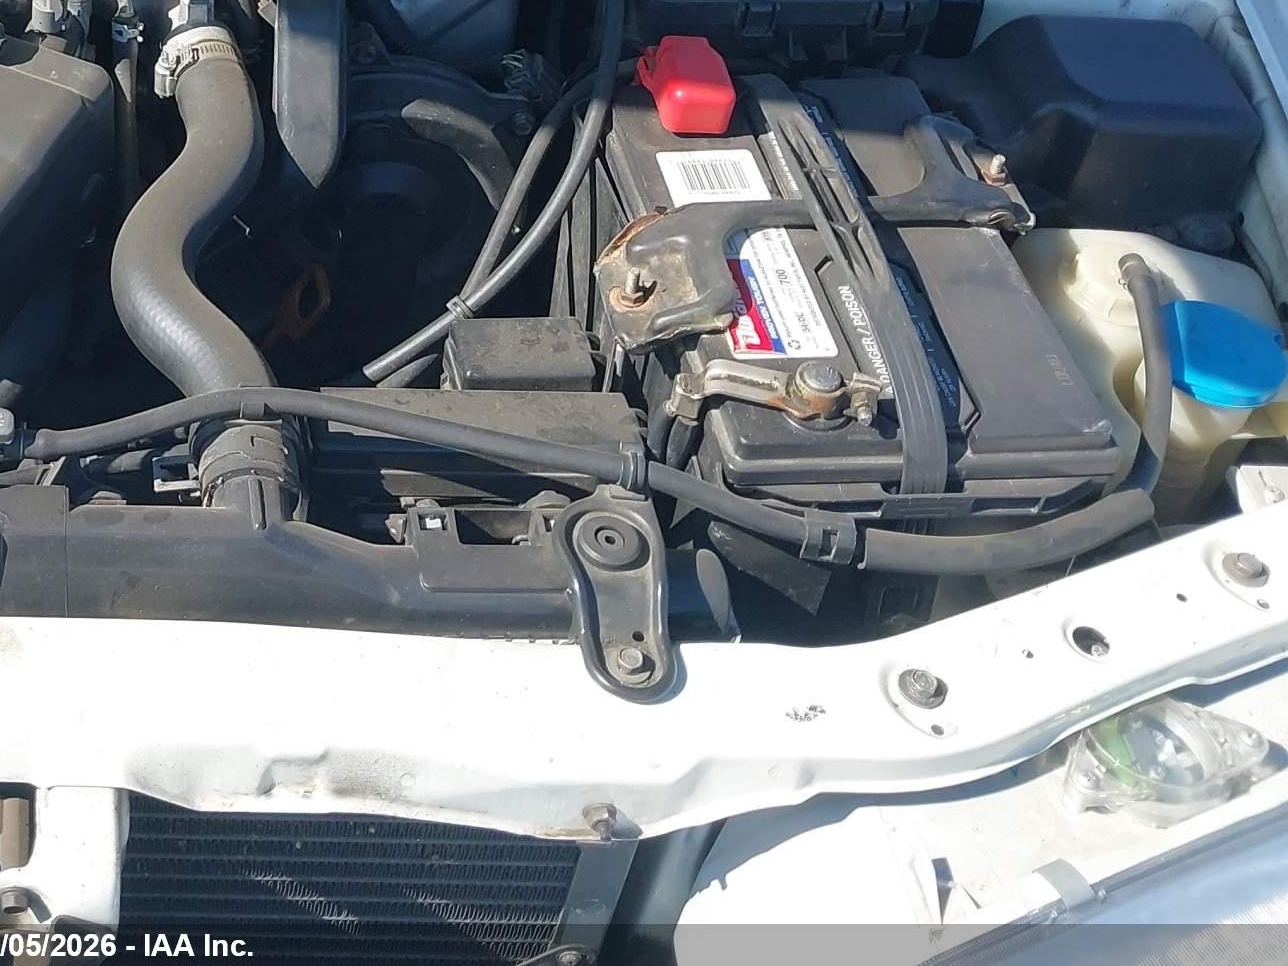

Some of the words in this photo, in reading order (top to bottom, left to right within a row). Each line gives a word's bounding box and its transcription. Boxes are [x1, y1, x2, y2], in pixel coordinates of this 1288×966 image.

[747, 275, 765, 306] TOUGH
[775, 268, 791, 286] 700
[760, 304, 779, 340] PROVEN
[838, 282, 867, 327] POISON
[861, 336, 890, 384] DANGER
